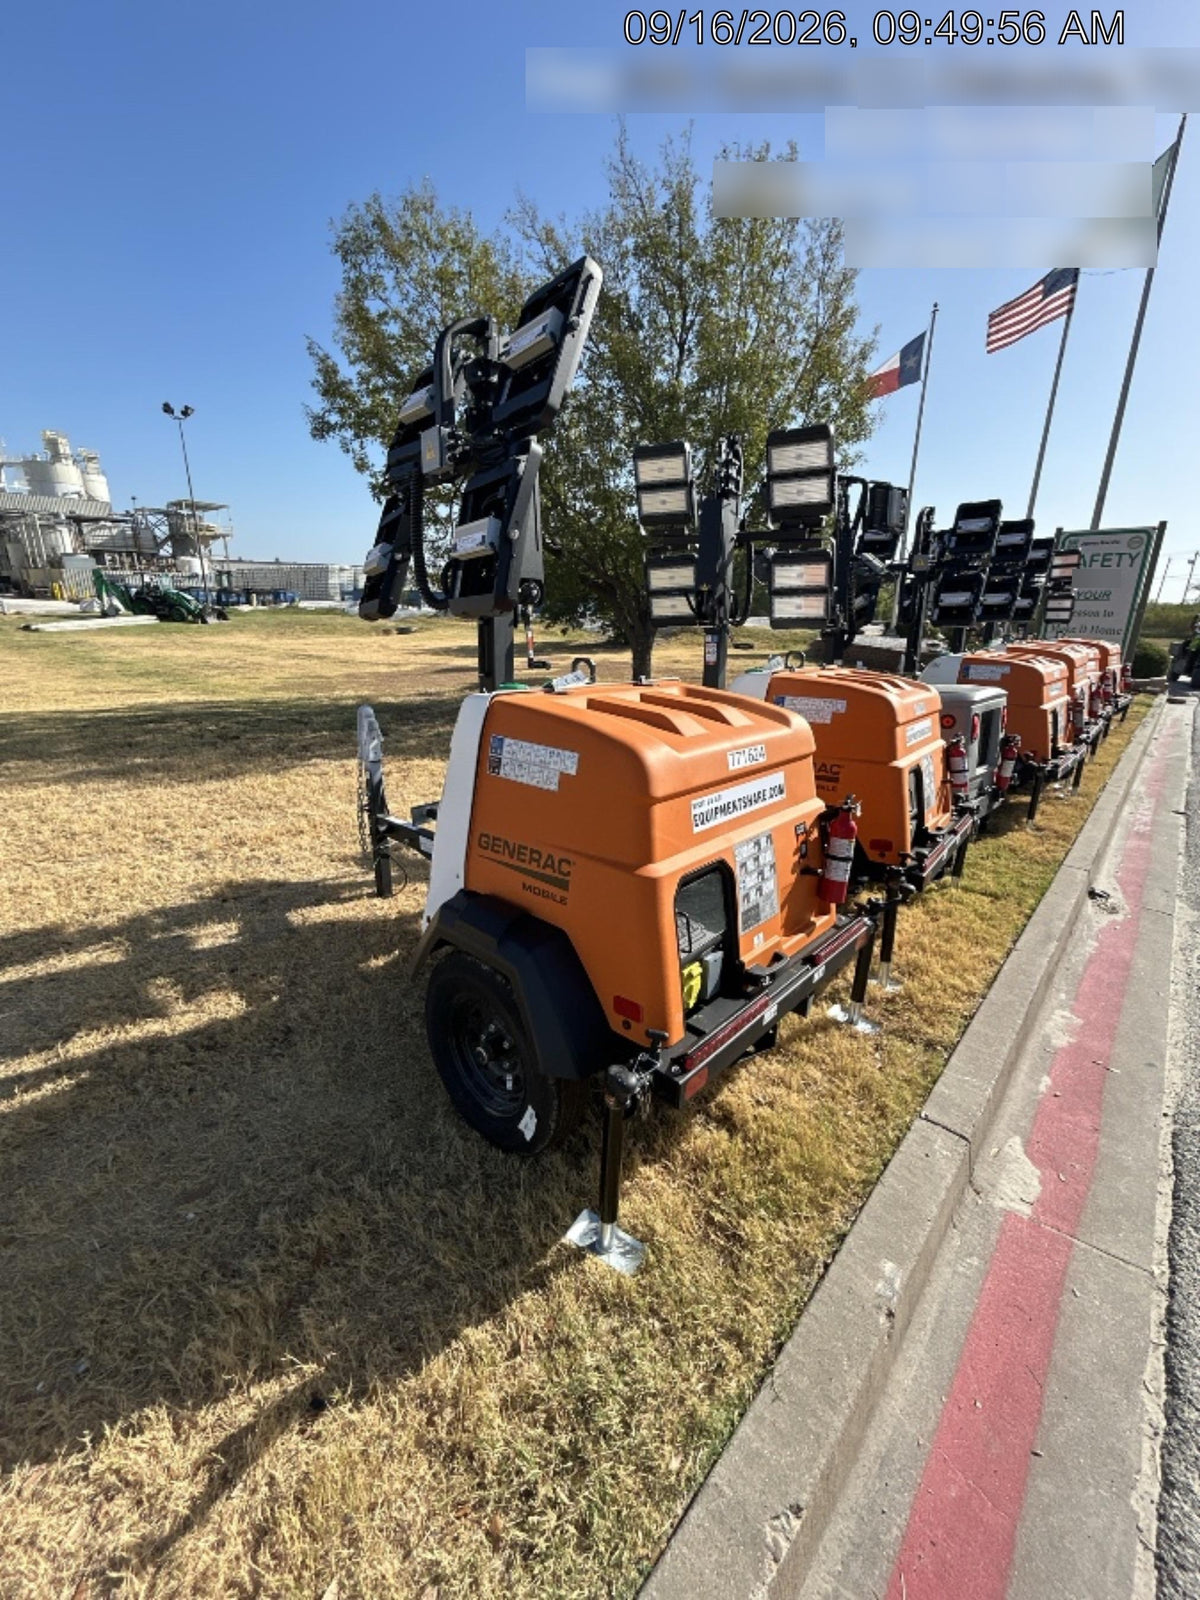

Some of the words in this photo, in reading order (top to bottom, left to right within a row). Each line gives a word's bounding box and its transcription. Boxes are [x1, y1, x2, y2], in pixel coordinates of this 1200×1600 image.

[1080, 552, 1140, 568] AFETY
[1077, 590, 1112, 601] YOUR
[477, 832, 572, 877] GENERAC
[521, 881, 569, 906] MOBILE
